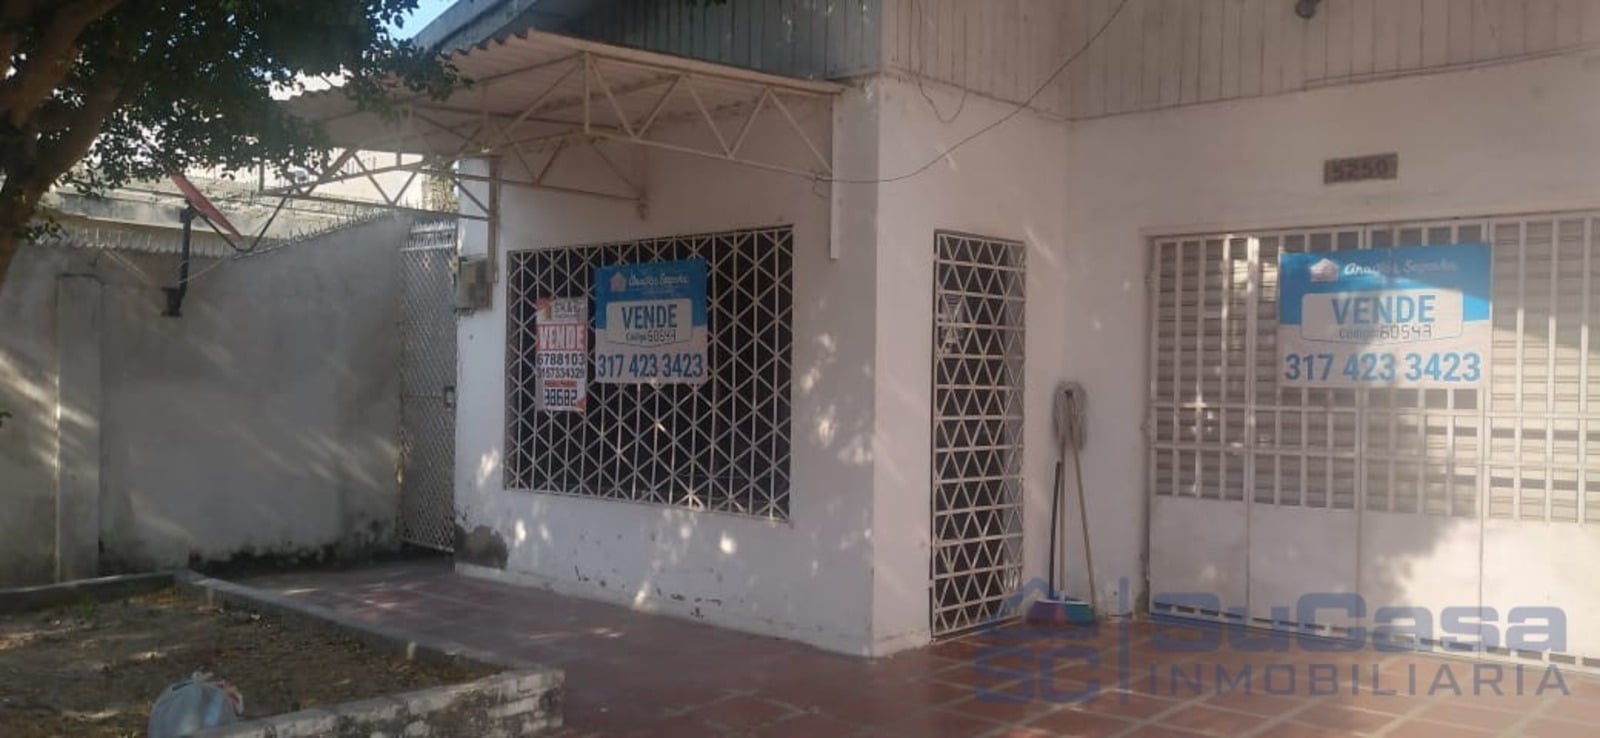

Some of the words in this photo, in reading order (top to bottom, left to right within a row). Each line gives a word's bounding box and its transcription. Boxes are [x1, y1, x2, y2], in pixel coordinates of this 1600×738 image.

[622, 303, 678, 329] VENDE
[1331, 295, 1436, 324] VENDE
[537, 324, 586, 350] VENDE
[536, 352, 586, 366] 6788103
[598, 354, 625, 378] 317
[628, 353, 658, 378] 423
[662, 352, 704, 378] 3423
[1285, 353, 1336, 381] 317
[1343, 353, 1396, 382] 423
[1405, 352, 1481, 382] 3423
